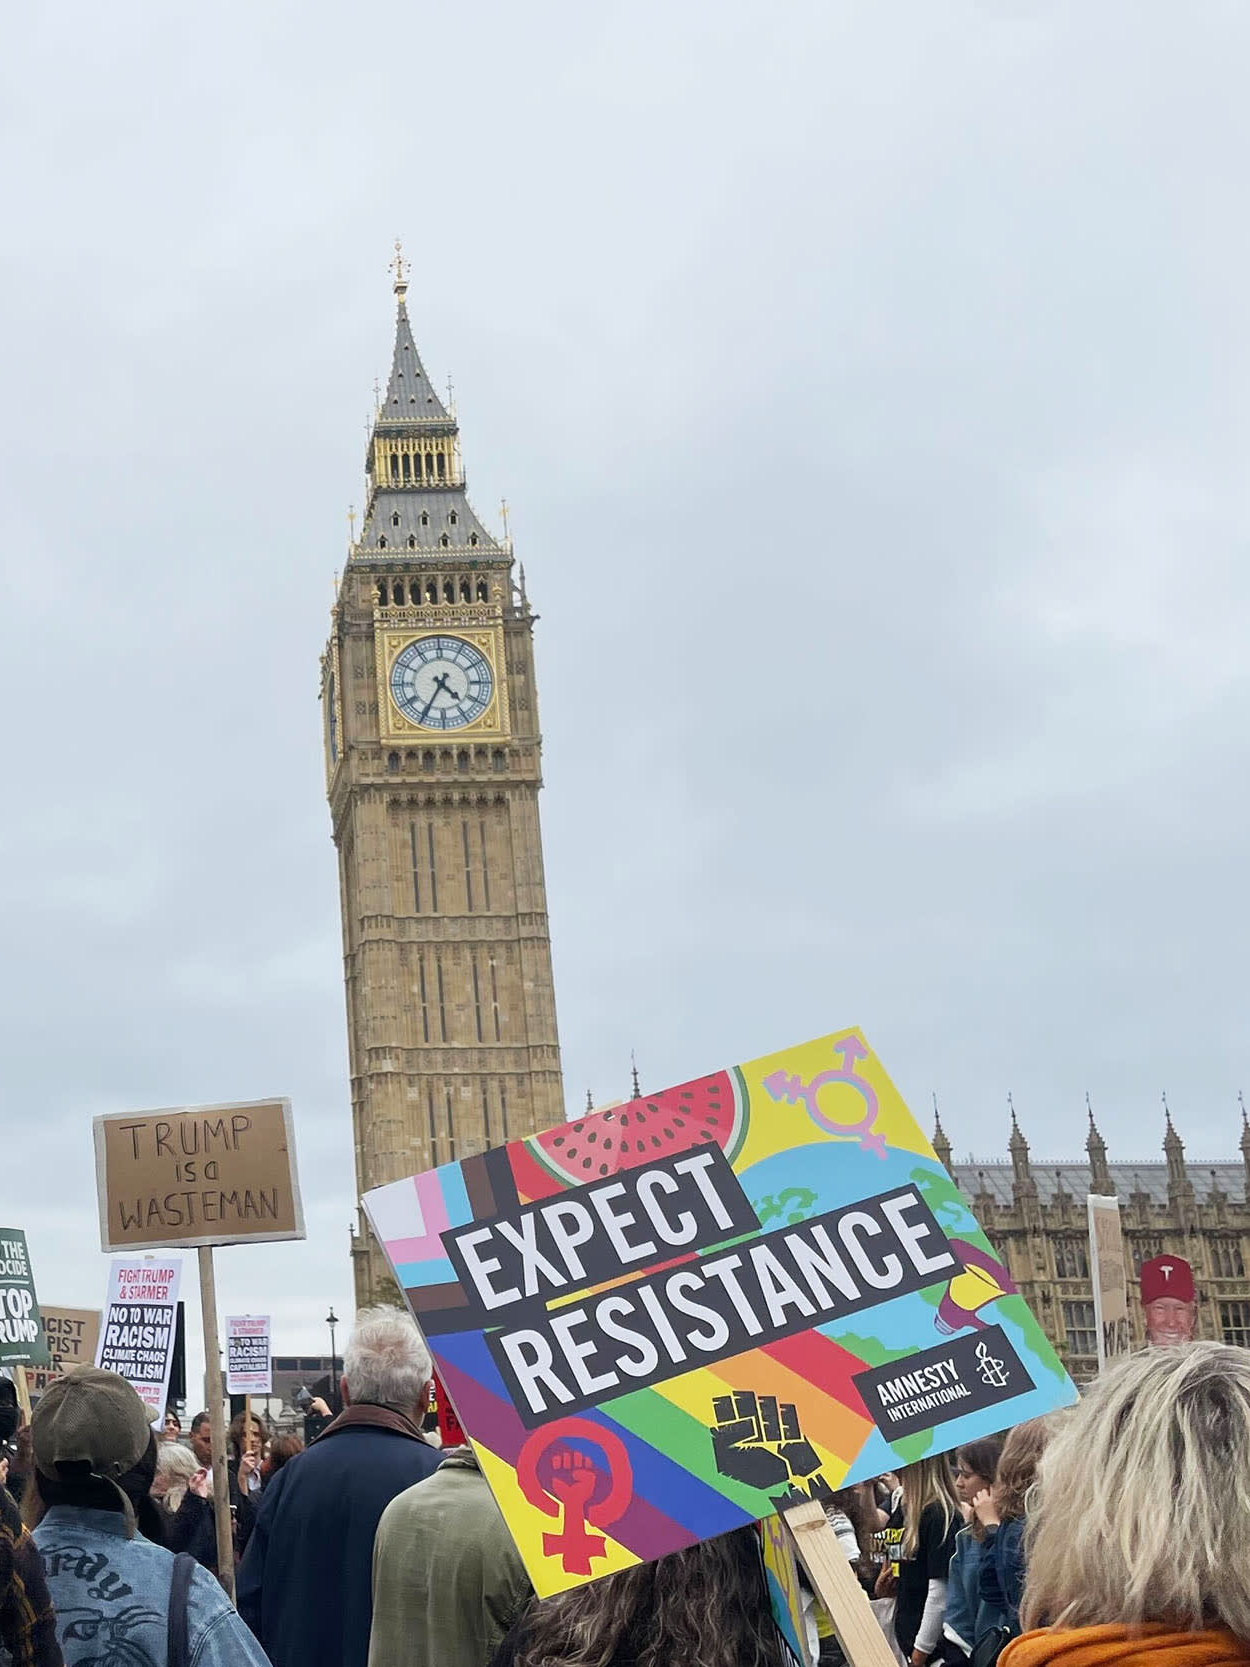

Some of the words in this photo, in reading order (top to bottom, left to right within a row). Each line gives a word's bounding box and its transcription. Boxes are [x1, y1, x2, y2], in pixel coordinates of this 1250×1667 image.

[119, 1115, 252, 1160] TRUMP
[204, 1161, 219, 1181] a
[119, 1188, 278, 1230] WASTEMAN
[455, 1152, 734, 1311] EXPECT
[0, 1240, 26, 1260] THE
[118, 1269, 141, 1284] FIGHT
[141, 1269, 174, 1284] TRUMP
[119, 1286, 127, 1300] &
[128, 1285, 168, 1300] STARMER
[500, 1192, 955, 1415] RESISTANCE
[109, 1306, 128, 1323] NO
[130, 1307, 141, 1323] TO
[143, 1308, 173, 1325] WAR
[47, 1336, 82, 1355] PIST
[105, 1325, 169, 1350] RACISM
[103, 1348, 136, 1361] CLIMATE
[136, 1350, 166, 1363] CHAOS
[229, 1346, 267, 1357] RACISM
[102, 1361, 164, 1380] CAPITALISM
[876, 1358, 960, 1406] AMNESTY
[887, 1383, 971, 1422] INTERNATIONAL
